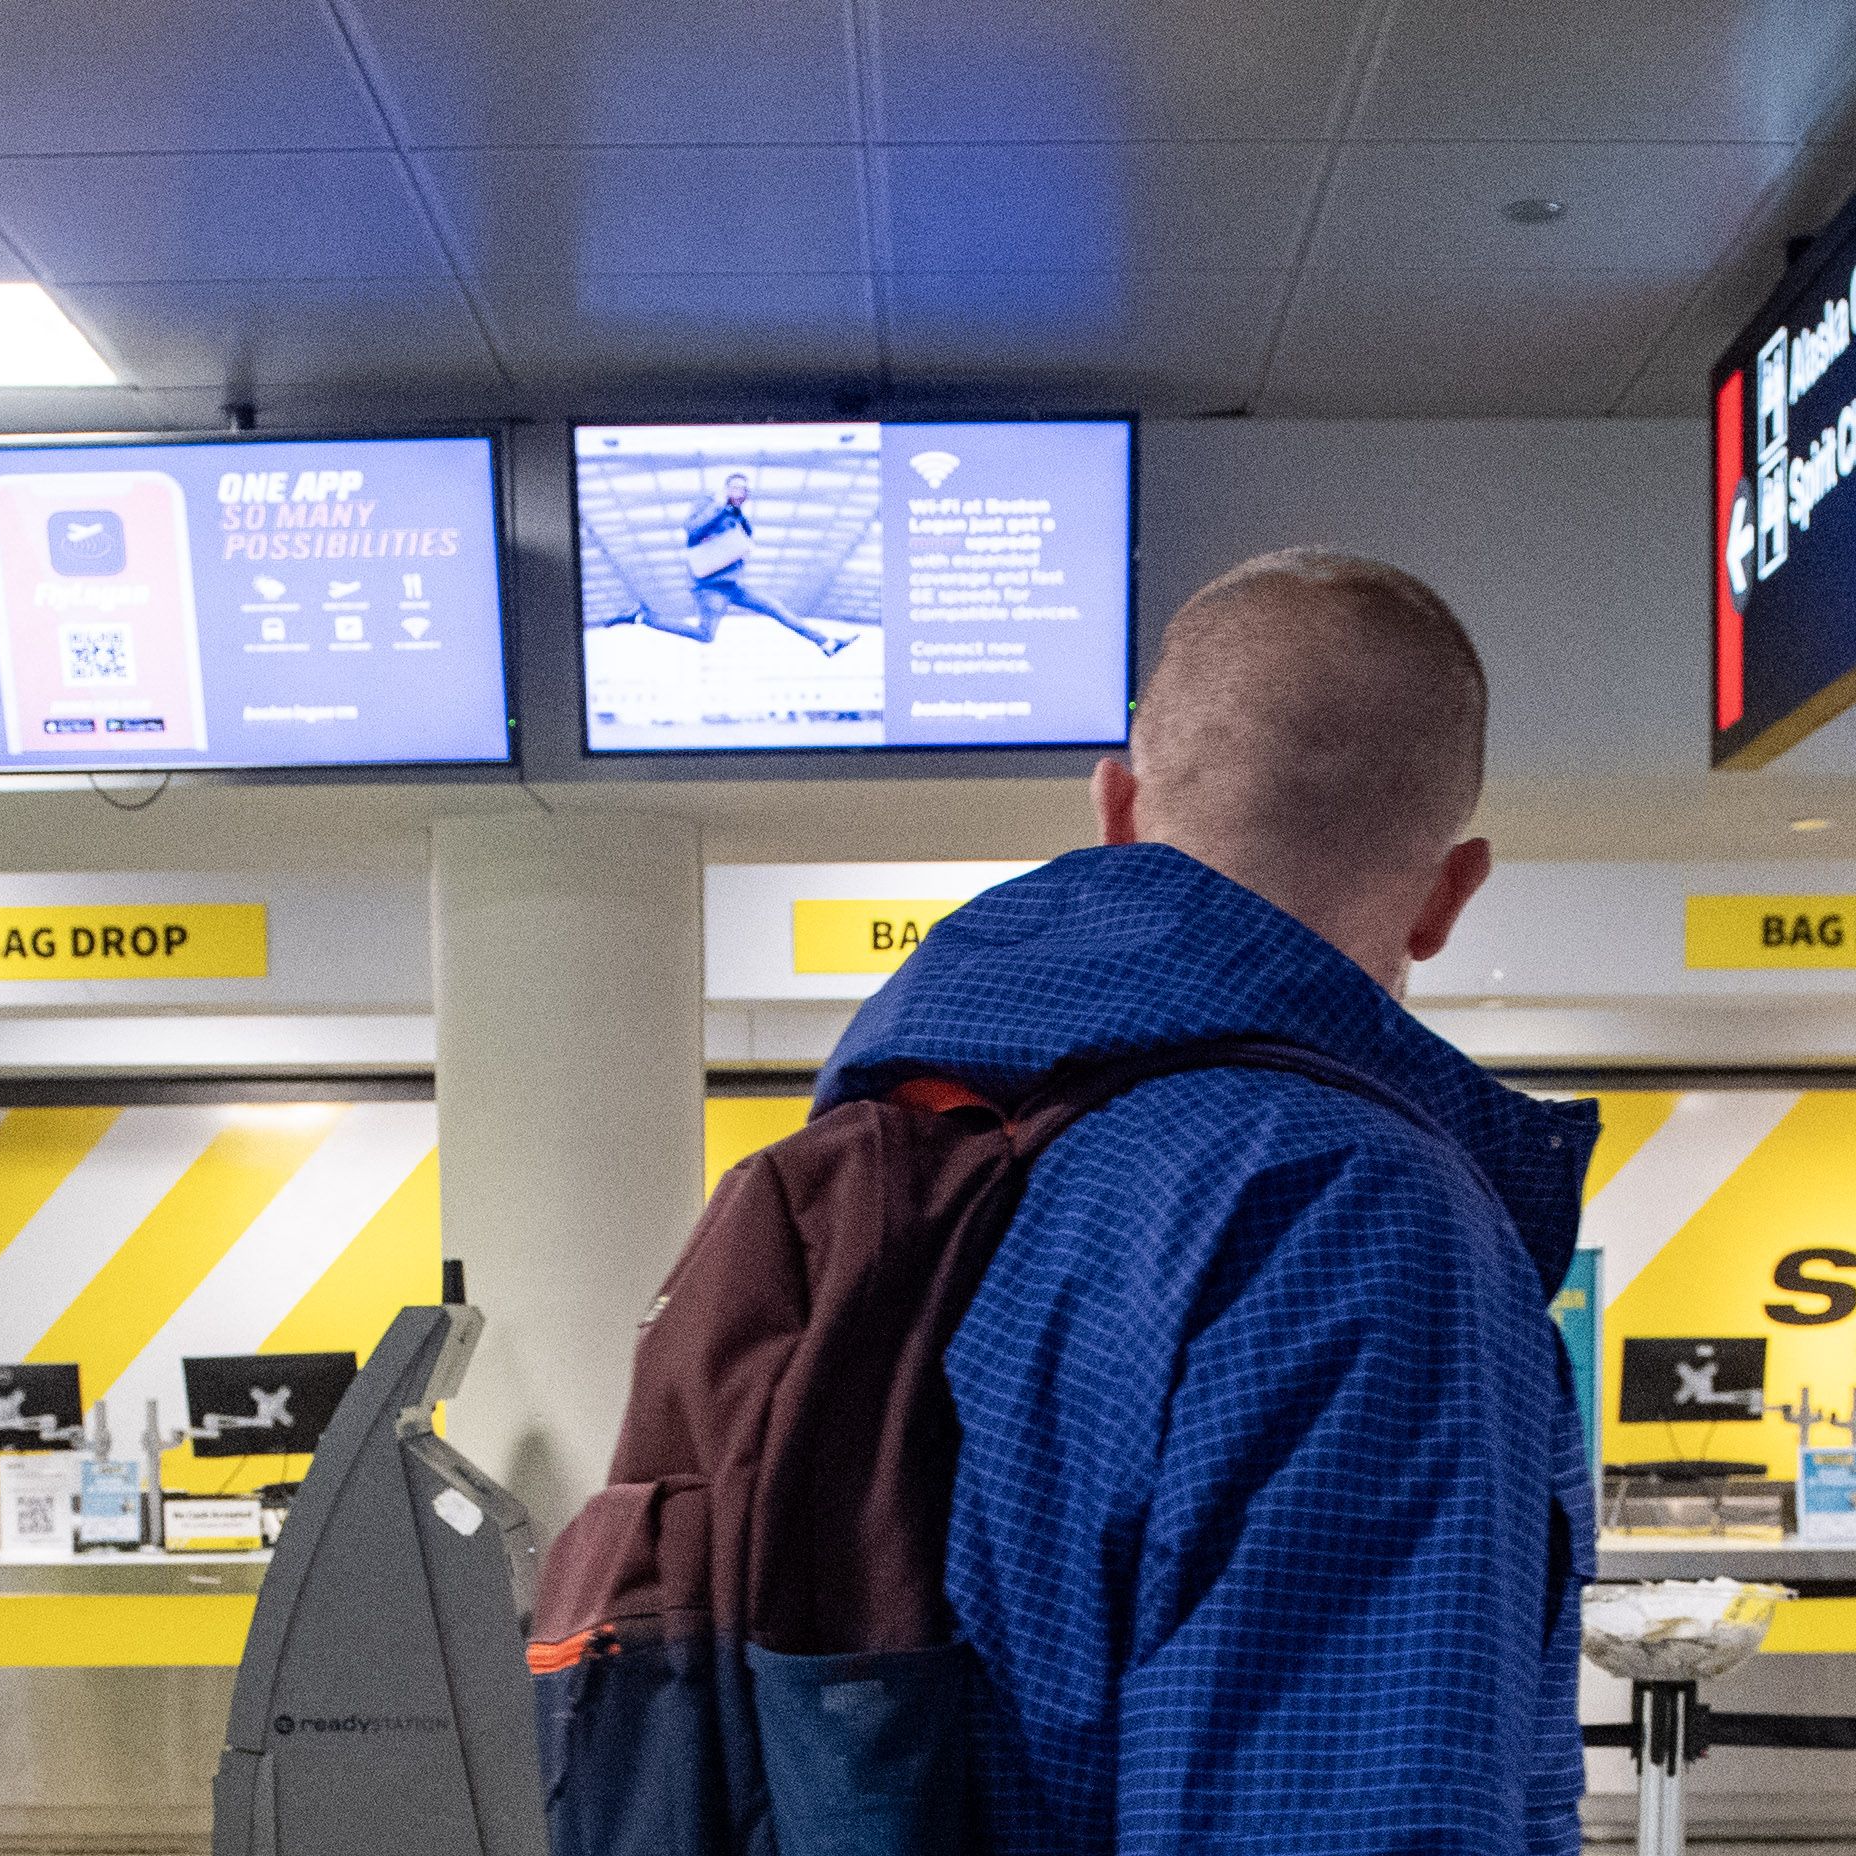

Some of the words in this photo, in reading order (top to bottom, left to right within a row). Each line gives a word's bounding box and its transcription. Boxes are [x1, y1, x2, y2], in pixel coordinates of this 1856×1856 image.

[1789, 298, 1850, 404] Alaska
[218, 471, 289, 504] ONE
[291, 470, 364, 502] APP
[1787, 425, 1838, 531] Spirit
[224, 504, 266, 530] SO
[276, 502, 377, 529] MANY
[224, 528, 460, 560] POSSIBILITIES
[71, 924, 189, 959] DROP
[872, 920, 922, 951] BA
[1761, 914, 1845, 949] BAG
